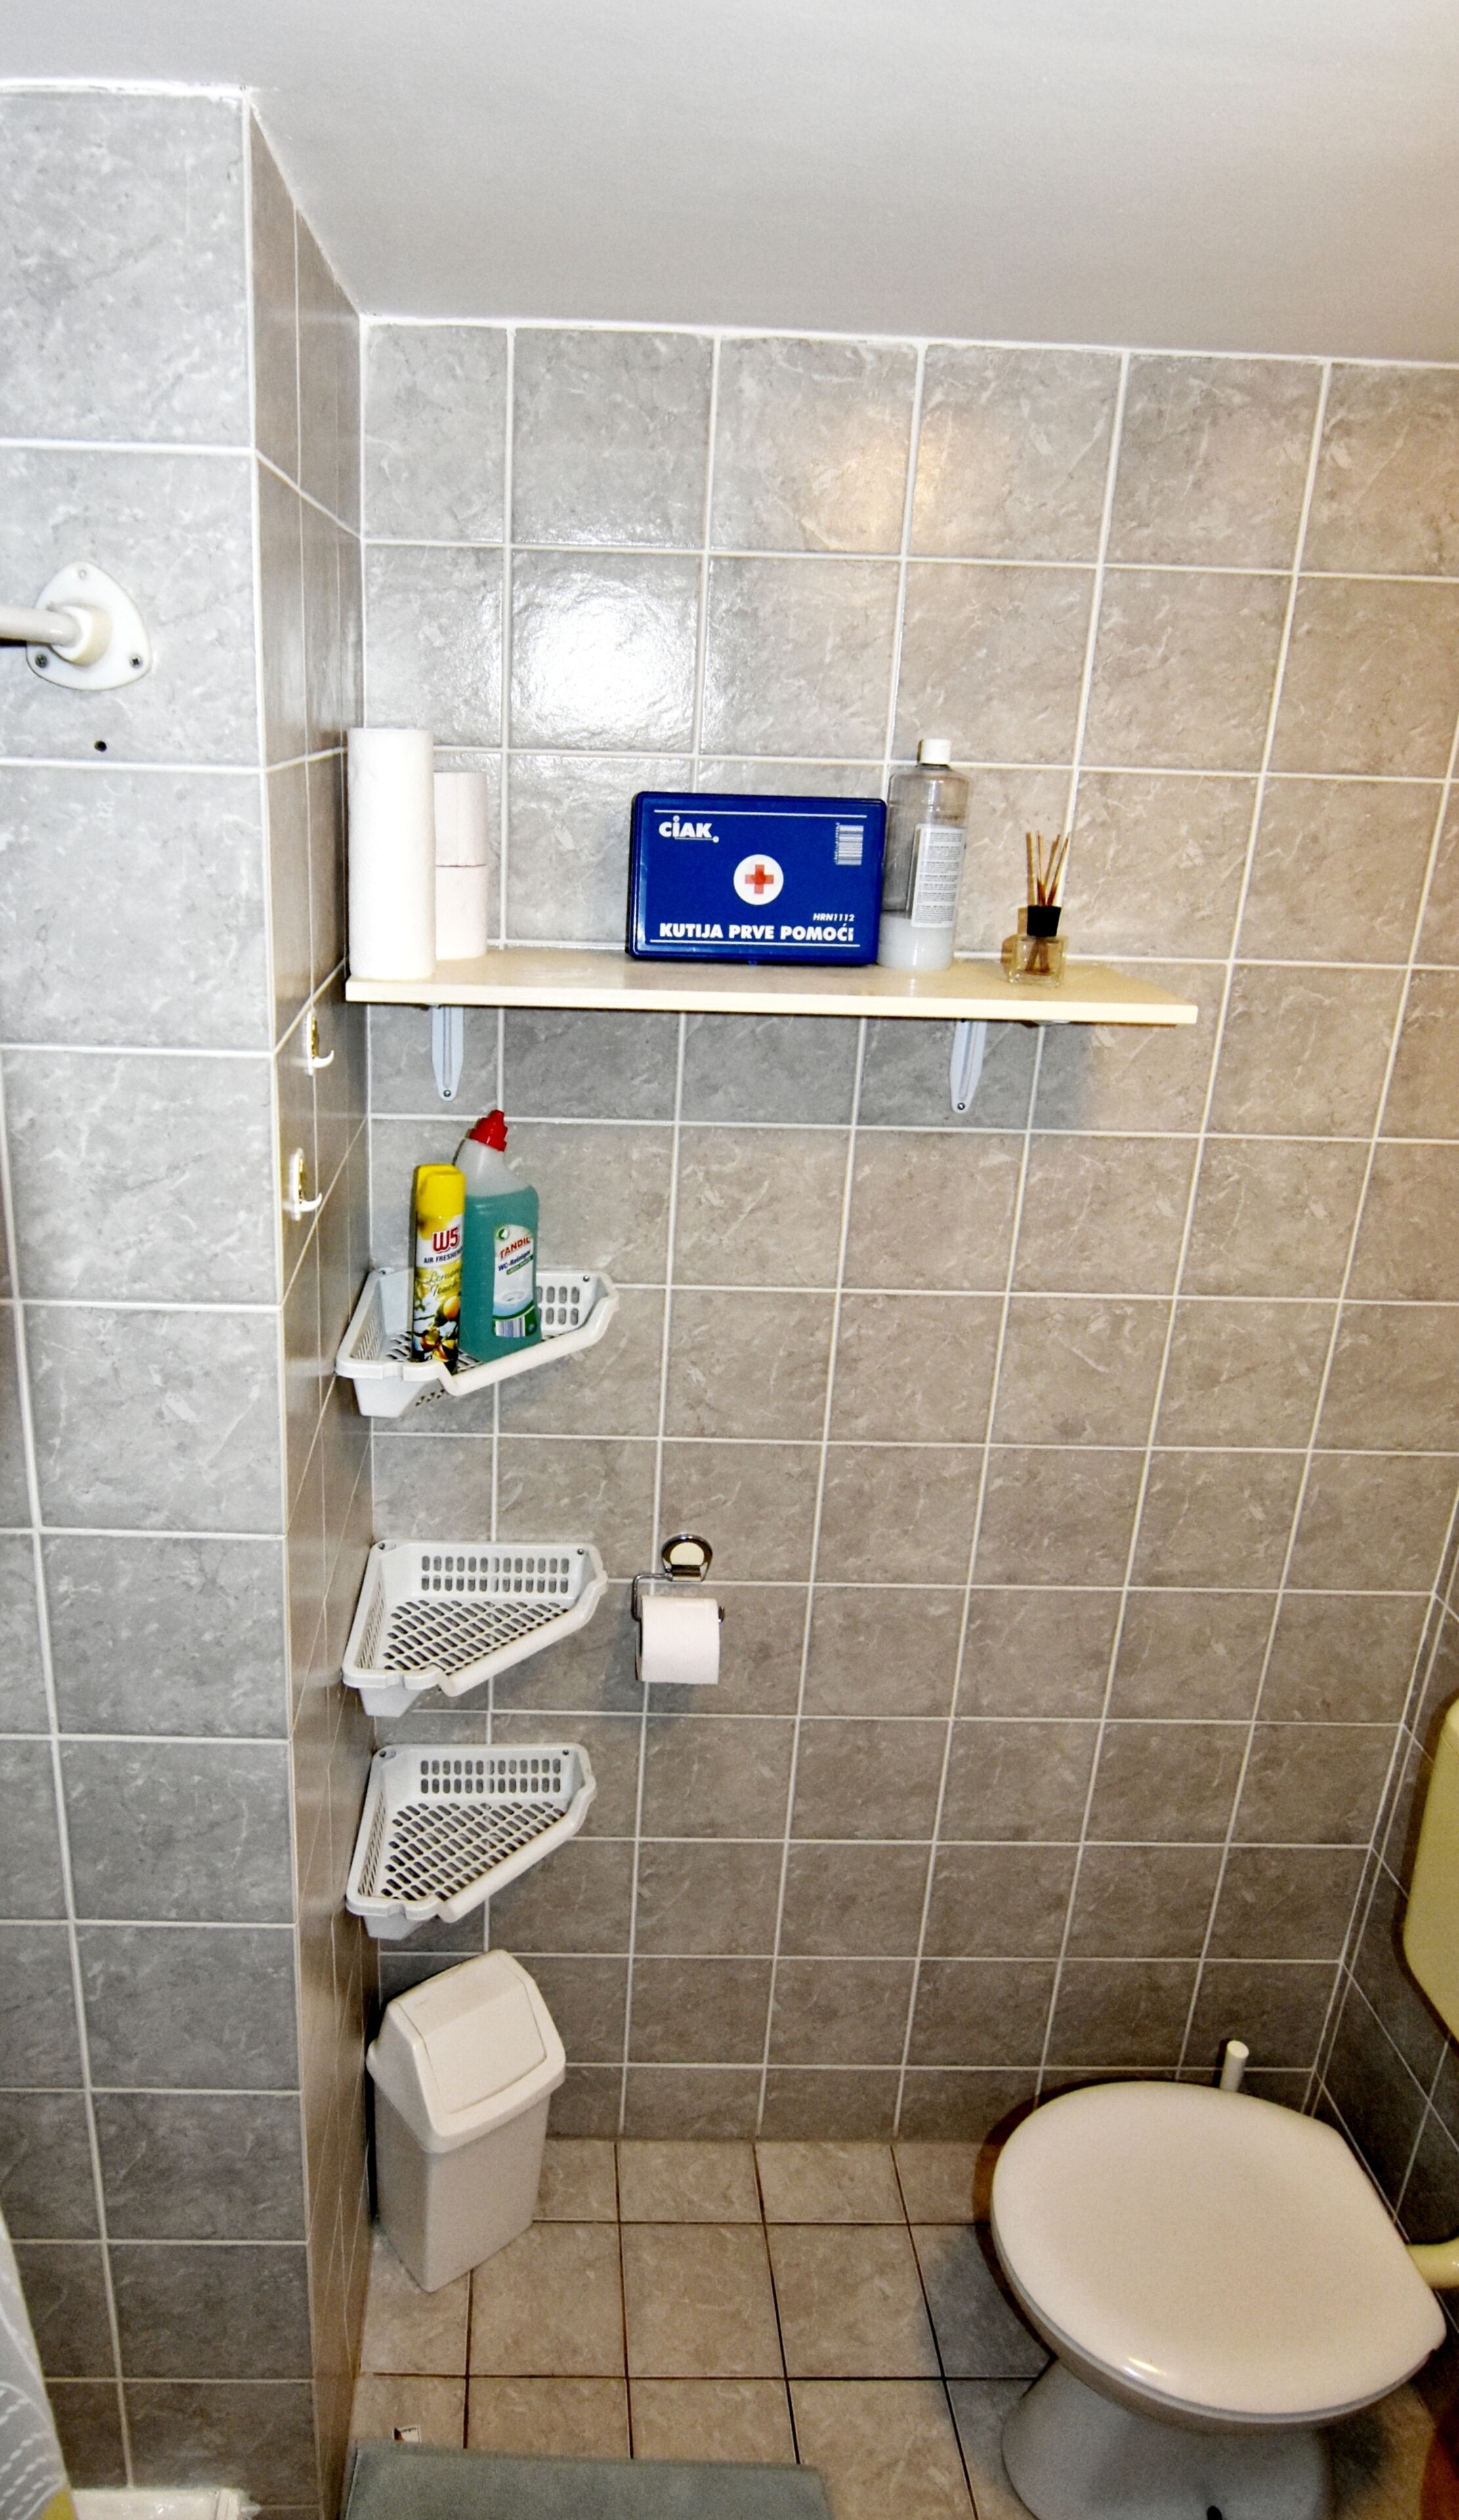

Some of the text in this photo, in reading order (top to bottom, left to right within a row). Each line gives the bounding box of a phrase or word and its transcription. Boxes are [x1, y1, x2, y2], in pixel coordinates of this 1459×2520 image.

[813, 913, 855, 921] HRN1112
[659, 923, 855, 942] KUTIJA PRVE POMOĆI
[433, 1226, 459, 1252] W5
[499, 1236, 531, 1259] TANDIL
